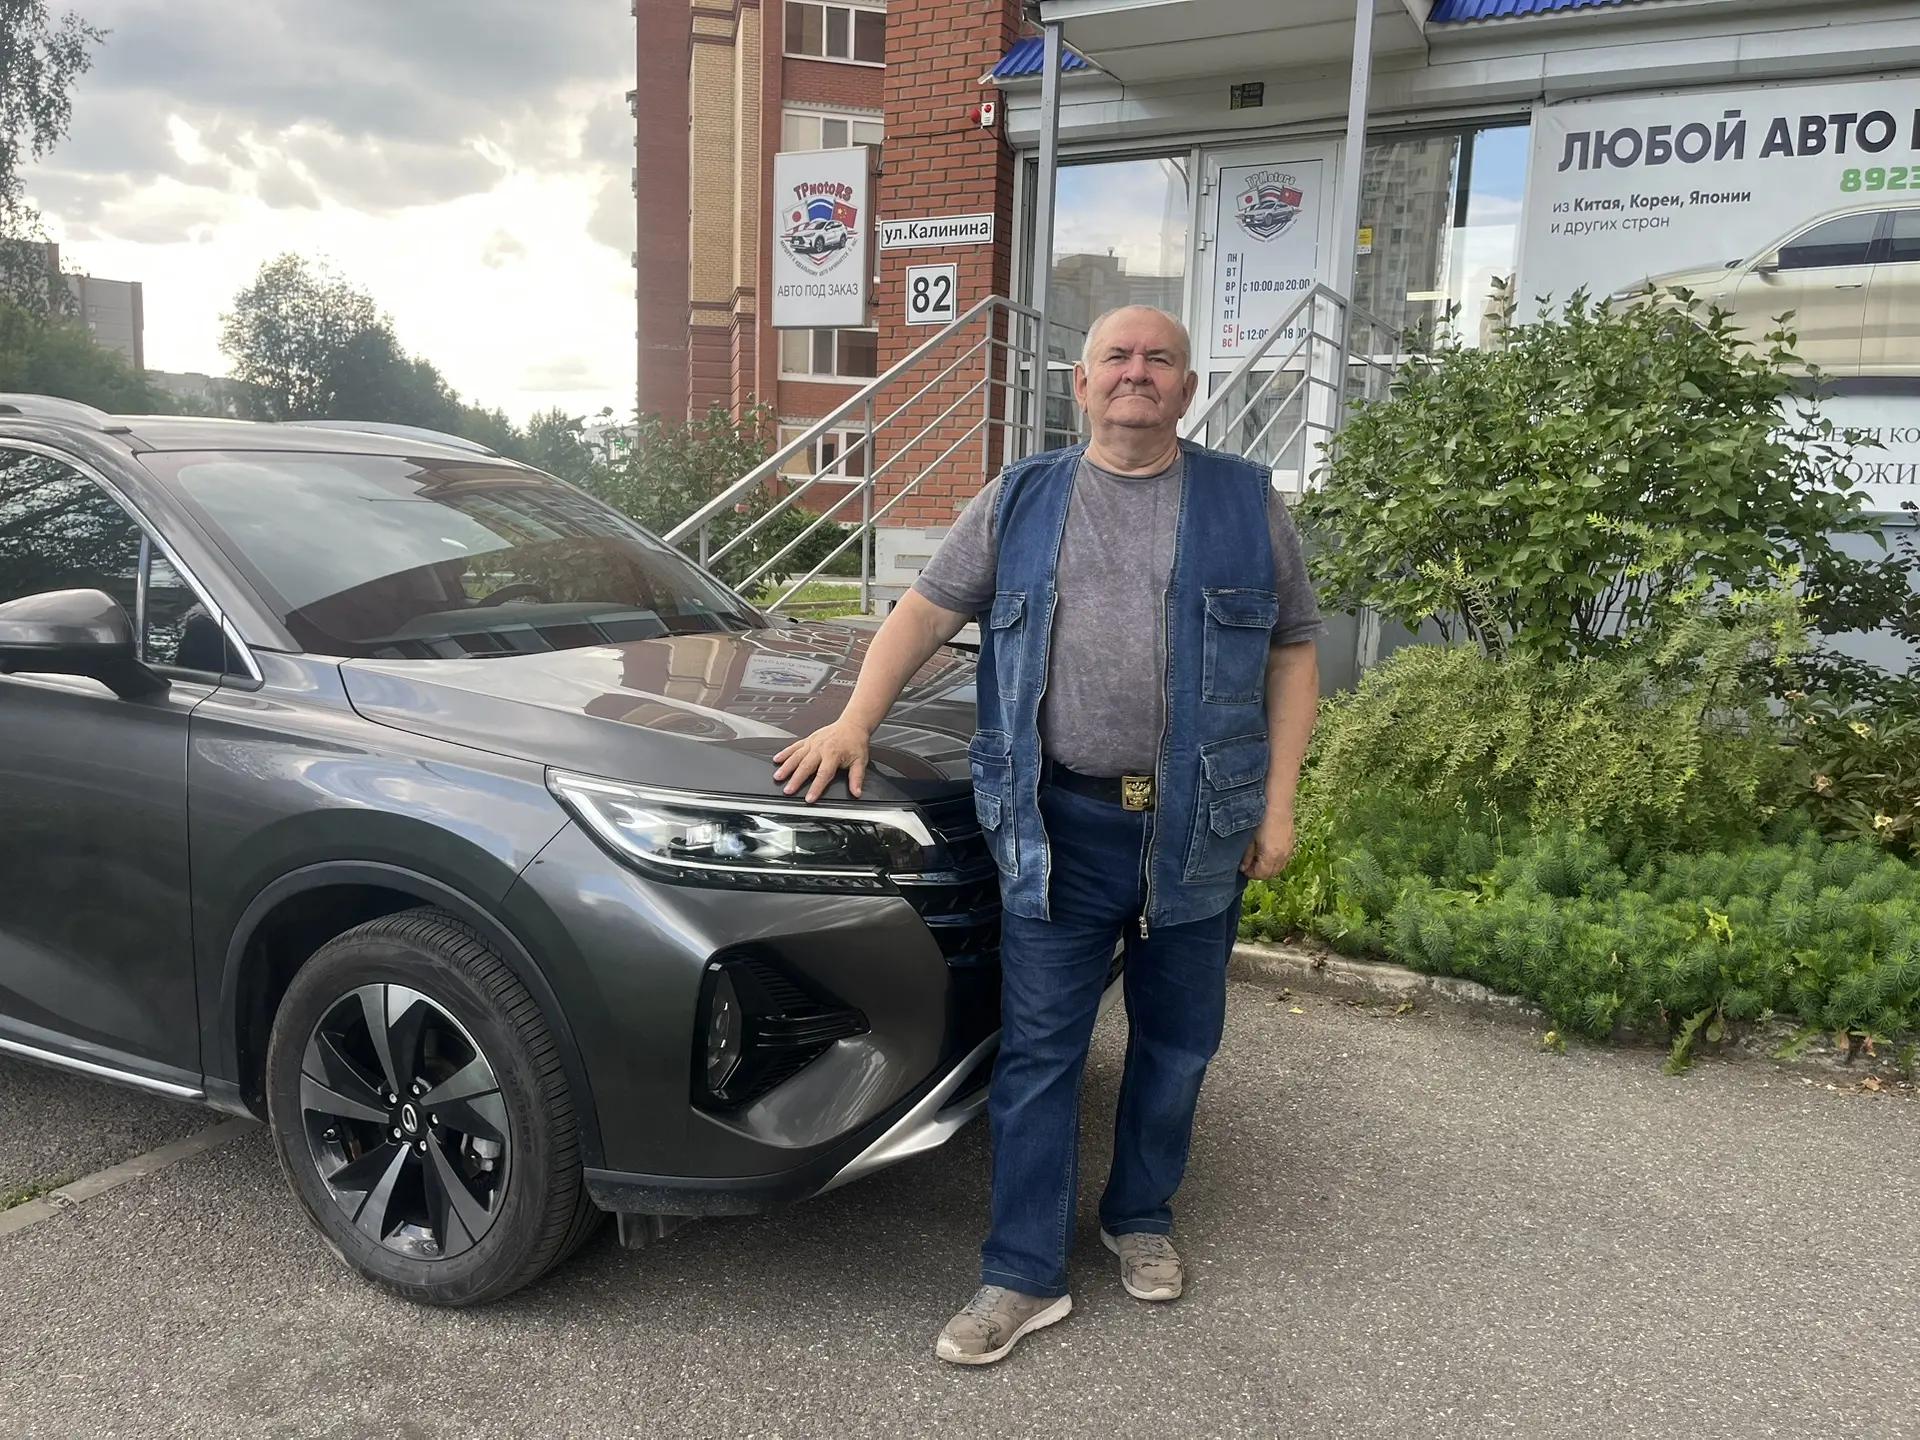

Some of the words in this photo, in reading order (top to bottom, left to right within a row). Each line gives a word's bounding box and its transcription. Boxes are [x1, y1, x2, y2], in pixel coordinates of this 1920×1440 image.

[1558, 109, 1747, 172] ЛЮБОЙ
[1759, 110, 1897, 159] АВТО
[1553, 202, 1570, 213] из
[1573, 197, 1625, 212] Китая,
[1630, 194, 1684, 211] Кореи,
[1689, 190, 1751, 205] Японии
[1551, 222, 1560, 233] и
[1563, 218, 1617, 236] других
[1622, 215, 1669, 232] стран
[884, 221, 989, 245] ул.Калинина
[1227, 253, 1238, 263] ПН
[1226, 267, 1237, 277] ВТ
[777, 285, 803, 297] АВТО
[804, 284, 826, 299] ПОД
[828, 283, 859, 296] ЗАКАЗ
[1250, 280, 1273, 292] 10:00
[1286, 279, 1310, 291] 20:00
[912, 275, 951, 313] 82
[1224, 296, 1235, 305] ЧТ
[1224, 310, 1235, 319] ПТ
[1223, 324, 1233, 333] СБ
[1222, 338, 1233, 348] ВС
